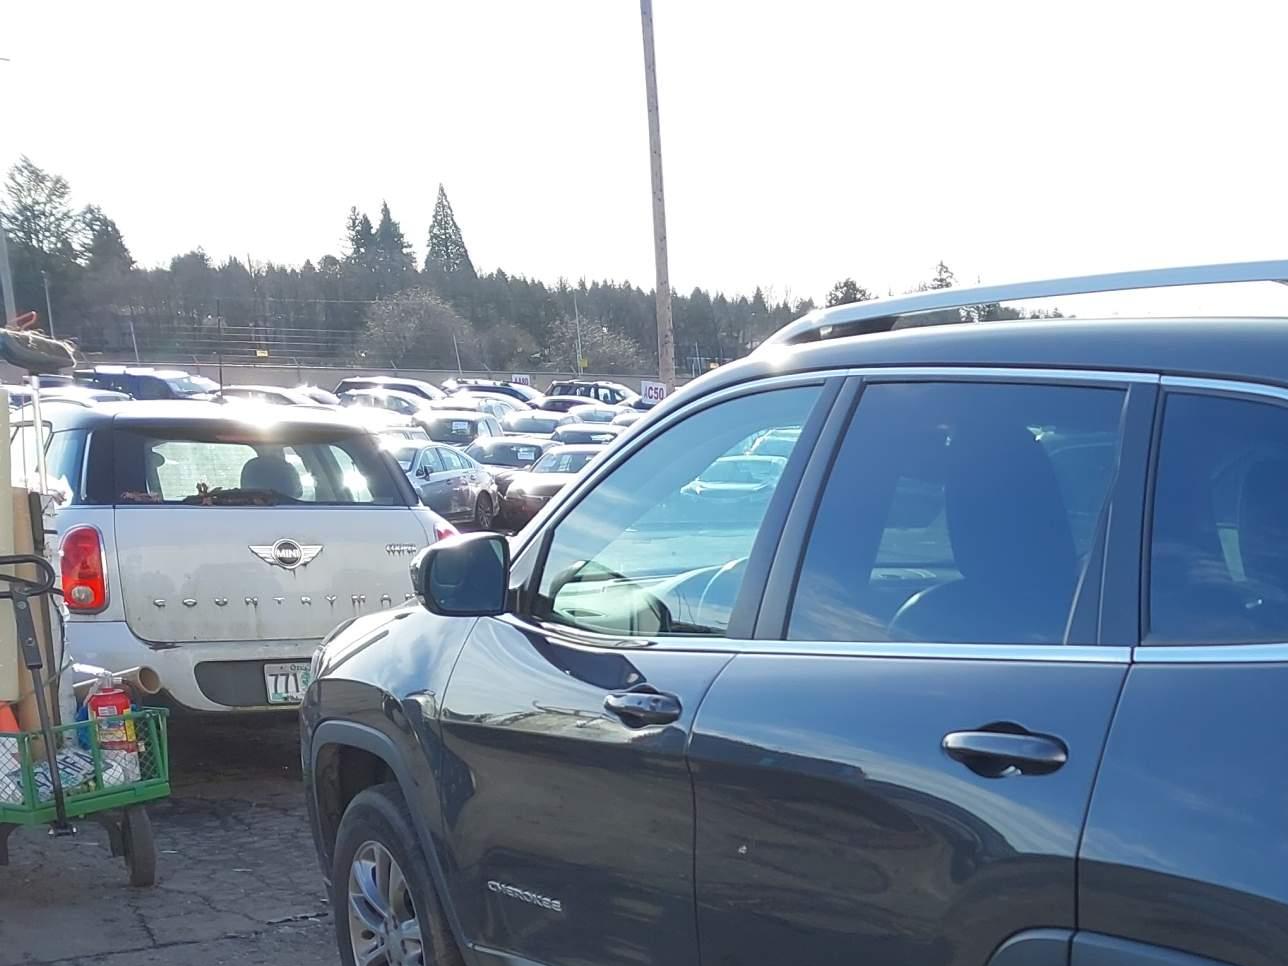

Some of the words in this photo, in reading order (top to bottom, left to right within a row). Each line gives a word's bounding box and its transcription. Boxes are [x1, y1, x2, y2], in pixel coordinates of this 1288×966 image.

[643, 385, 664, 400] AC50
[276, 549, 300, 558] MINI
[487, 880, 562, 912] CHEROKEE
